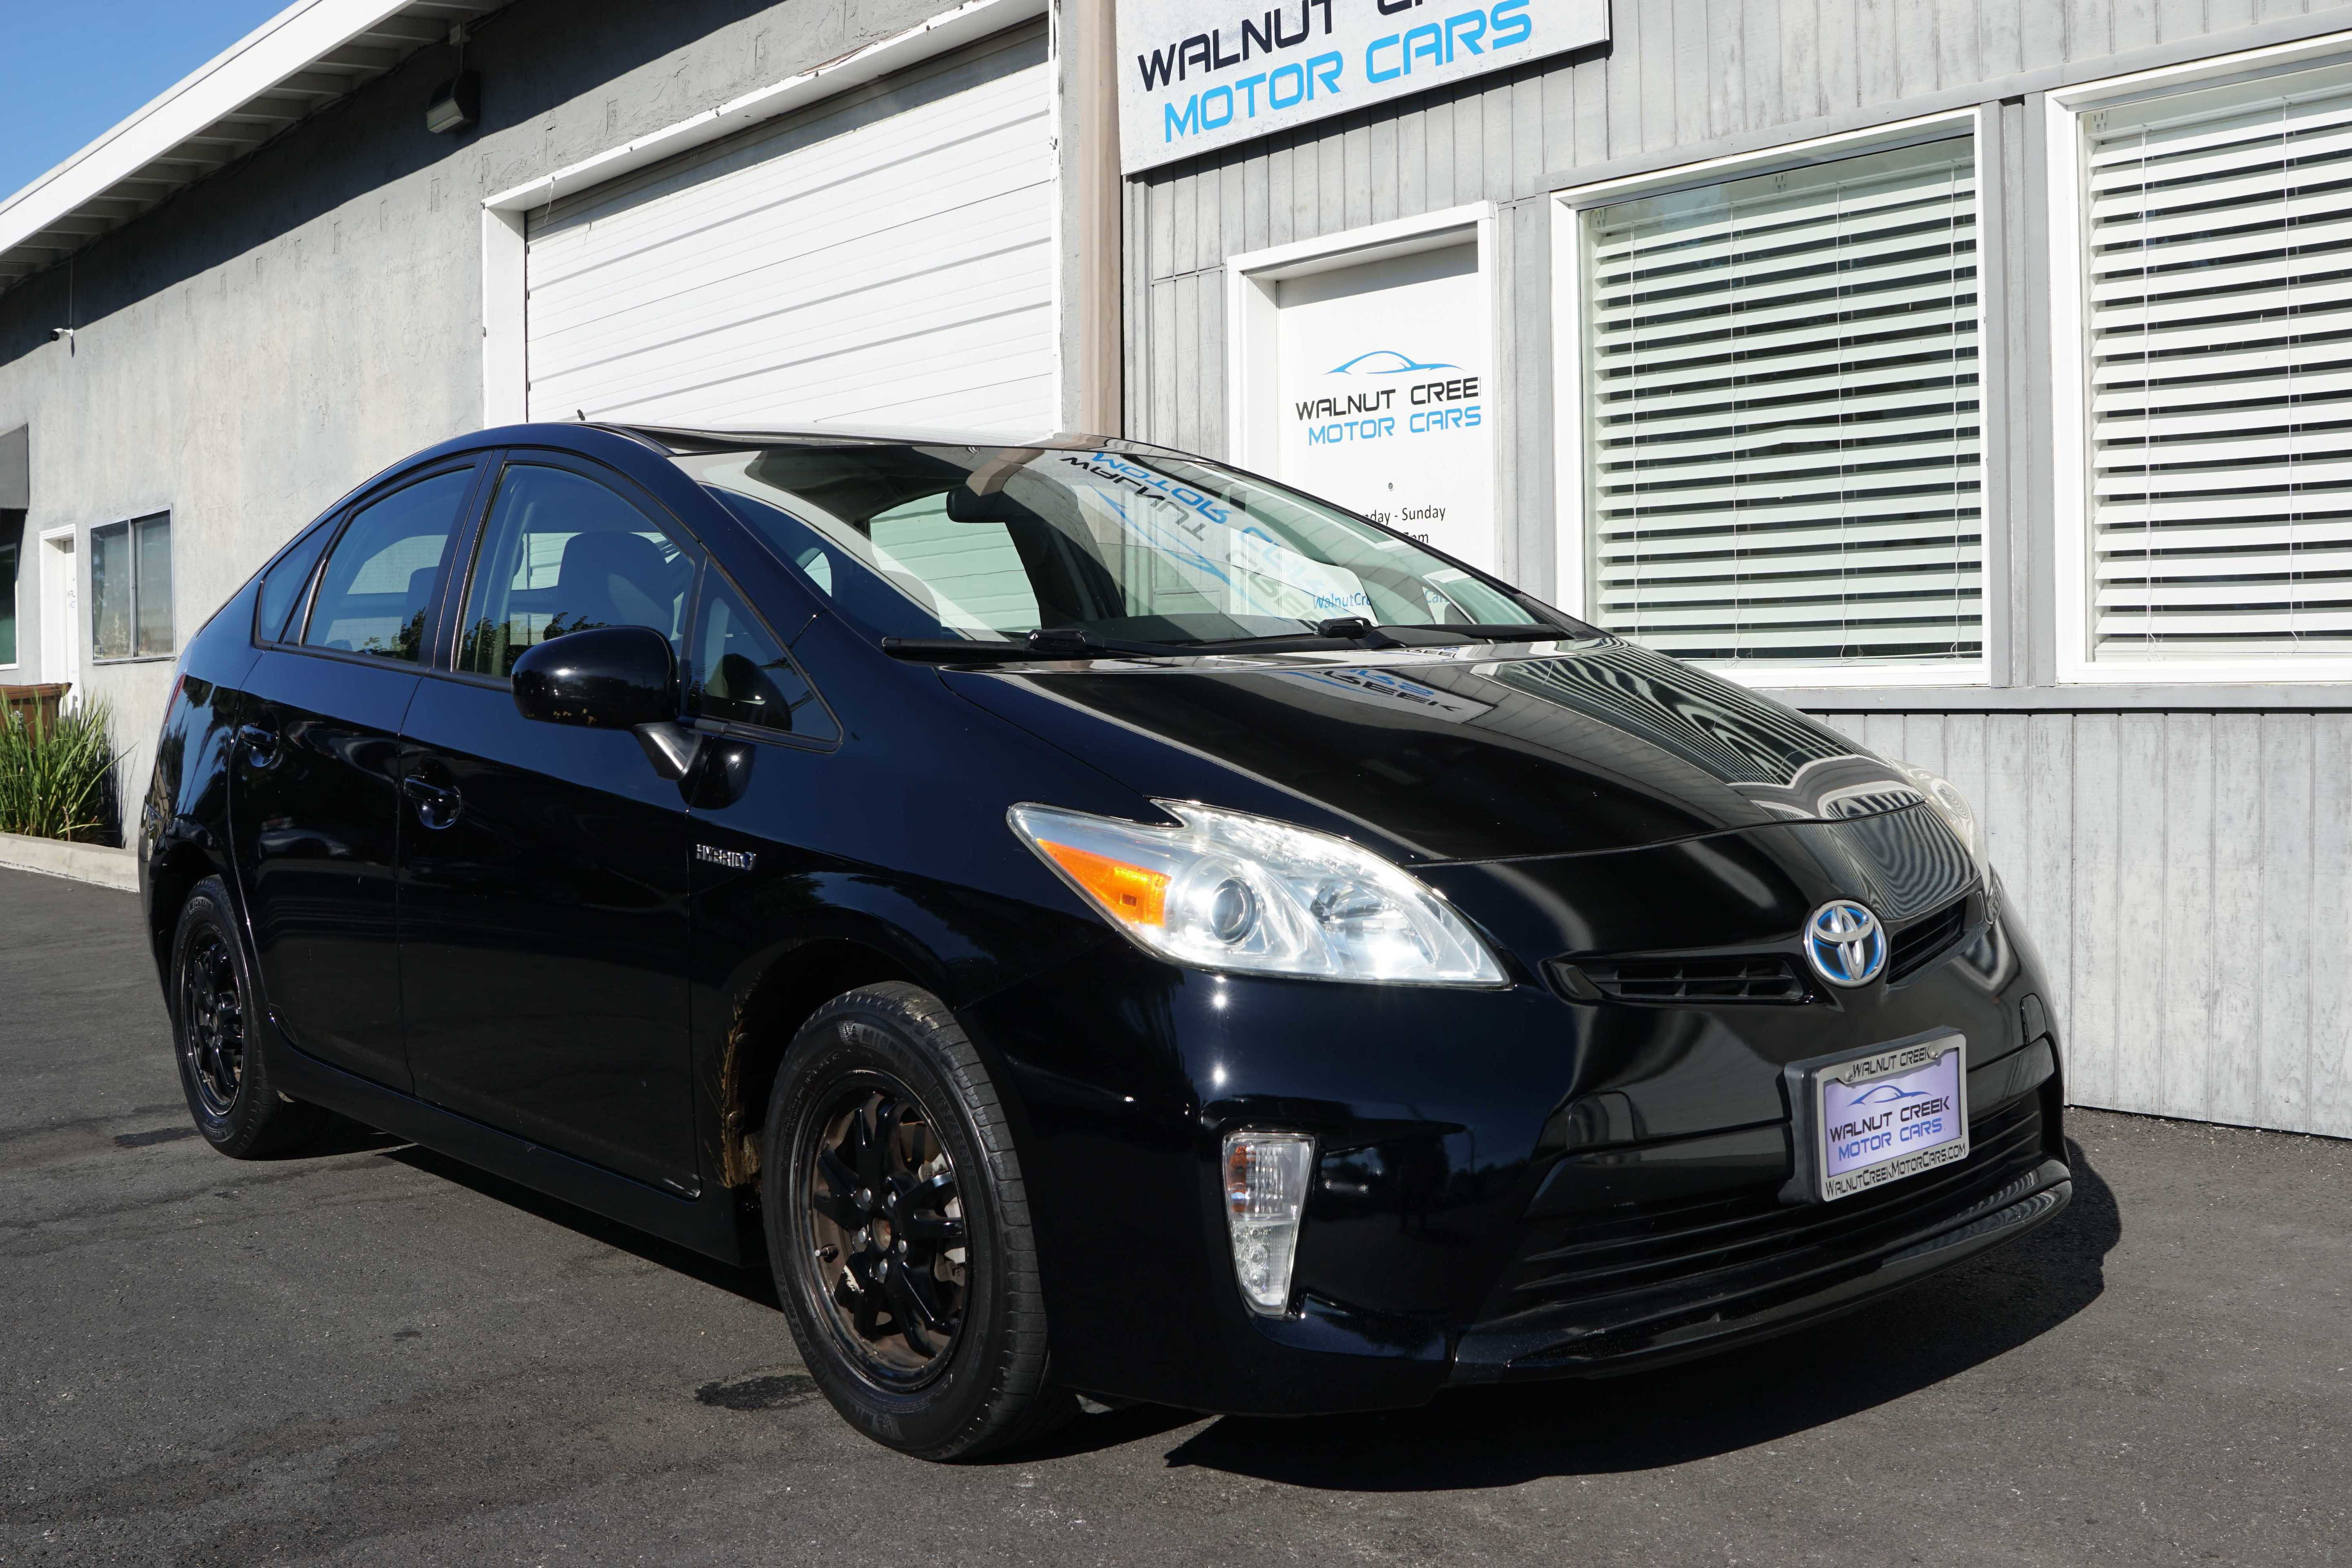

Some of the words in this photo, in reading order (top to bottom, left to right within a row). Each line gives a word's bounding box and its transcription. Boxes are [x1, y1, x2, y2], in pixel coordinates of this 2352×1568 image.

[1138, 0, 1332, 91] WALNUT
[1165, 51, 1343, 143] MOTOR
[1366, 0, 1532, 83] CARS
[1296, 389, 1396, 421] WALNUT
[1410, 376, 1481, 405] CREE
[1309, 417, 1395, 445] MOTOR
[1410, 405, 1481, 433] CARS
[1402, 505, 1446, 521] Sunday
[1853, 1055, 1897, 1078] WALNUT
[1900, 1045, 1931, 1067] CREEK
[1829, 1111, 1892, 1143] WALNUT
[1900, 1096, 1950, 1122] CREEK
[1838, 1131, 1891, 1161] MOTOR
[1900, 1118, 1942, 1142] CARS
